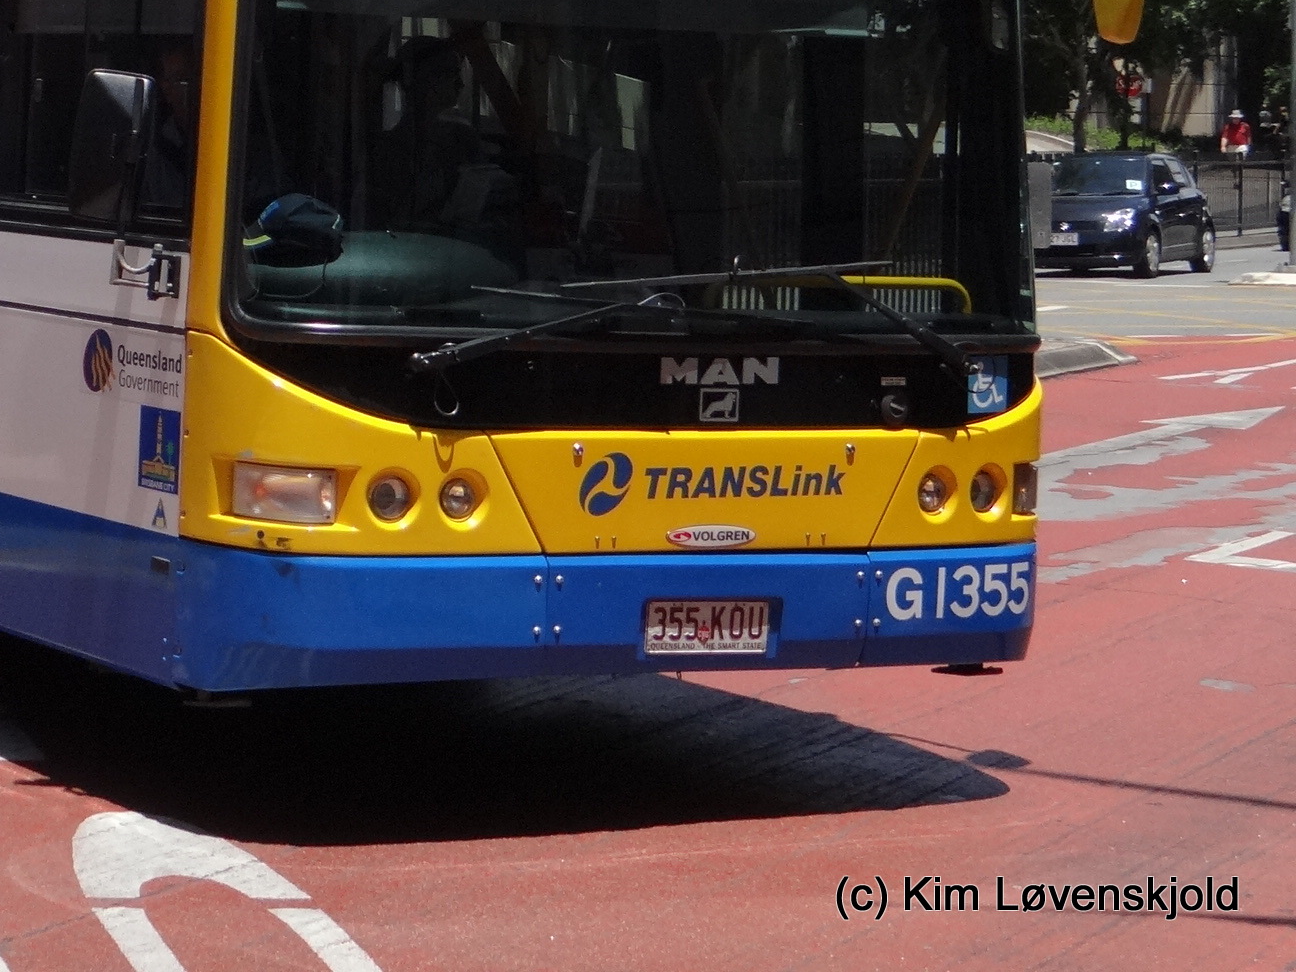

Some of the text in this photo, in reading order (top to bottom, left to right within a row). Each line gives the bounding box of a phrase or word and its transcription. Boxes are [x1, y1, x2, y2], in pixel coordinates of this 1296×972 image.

[117, 345, 183, 374] Queensland
[660, 357, 779, 385] MAN
[118, 369, 180, 397] Government
[644, 464, 846, 499] TRANSLink
[692, 530, 750, 542] VOLGREN
[886, 561, 1029, 621] G1355
[653, 606, 764, 640] 355 KOU
[650, 642, 695, 651] QUEENSLAND
[718, 642, 740, 650] SMART
[742, 642, 761, 650] STATE
